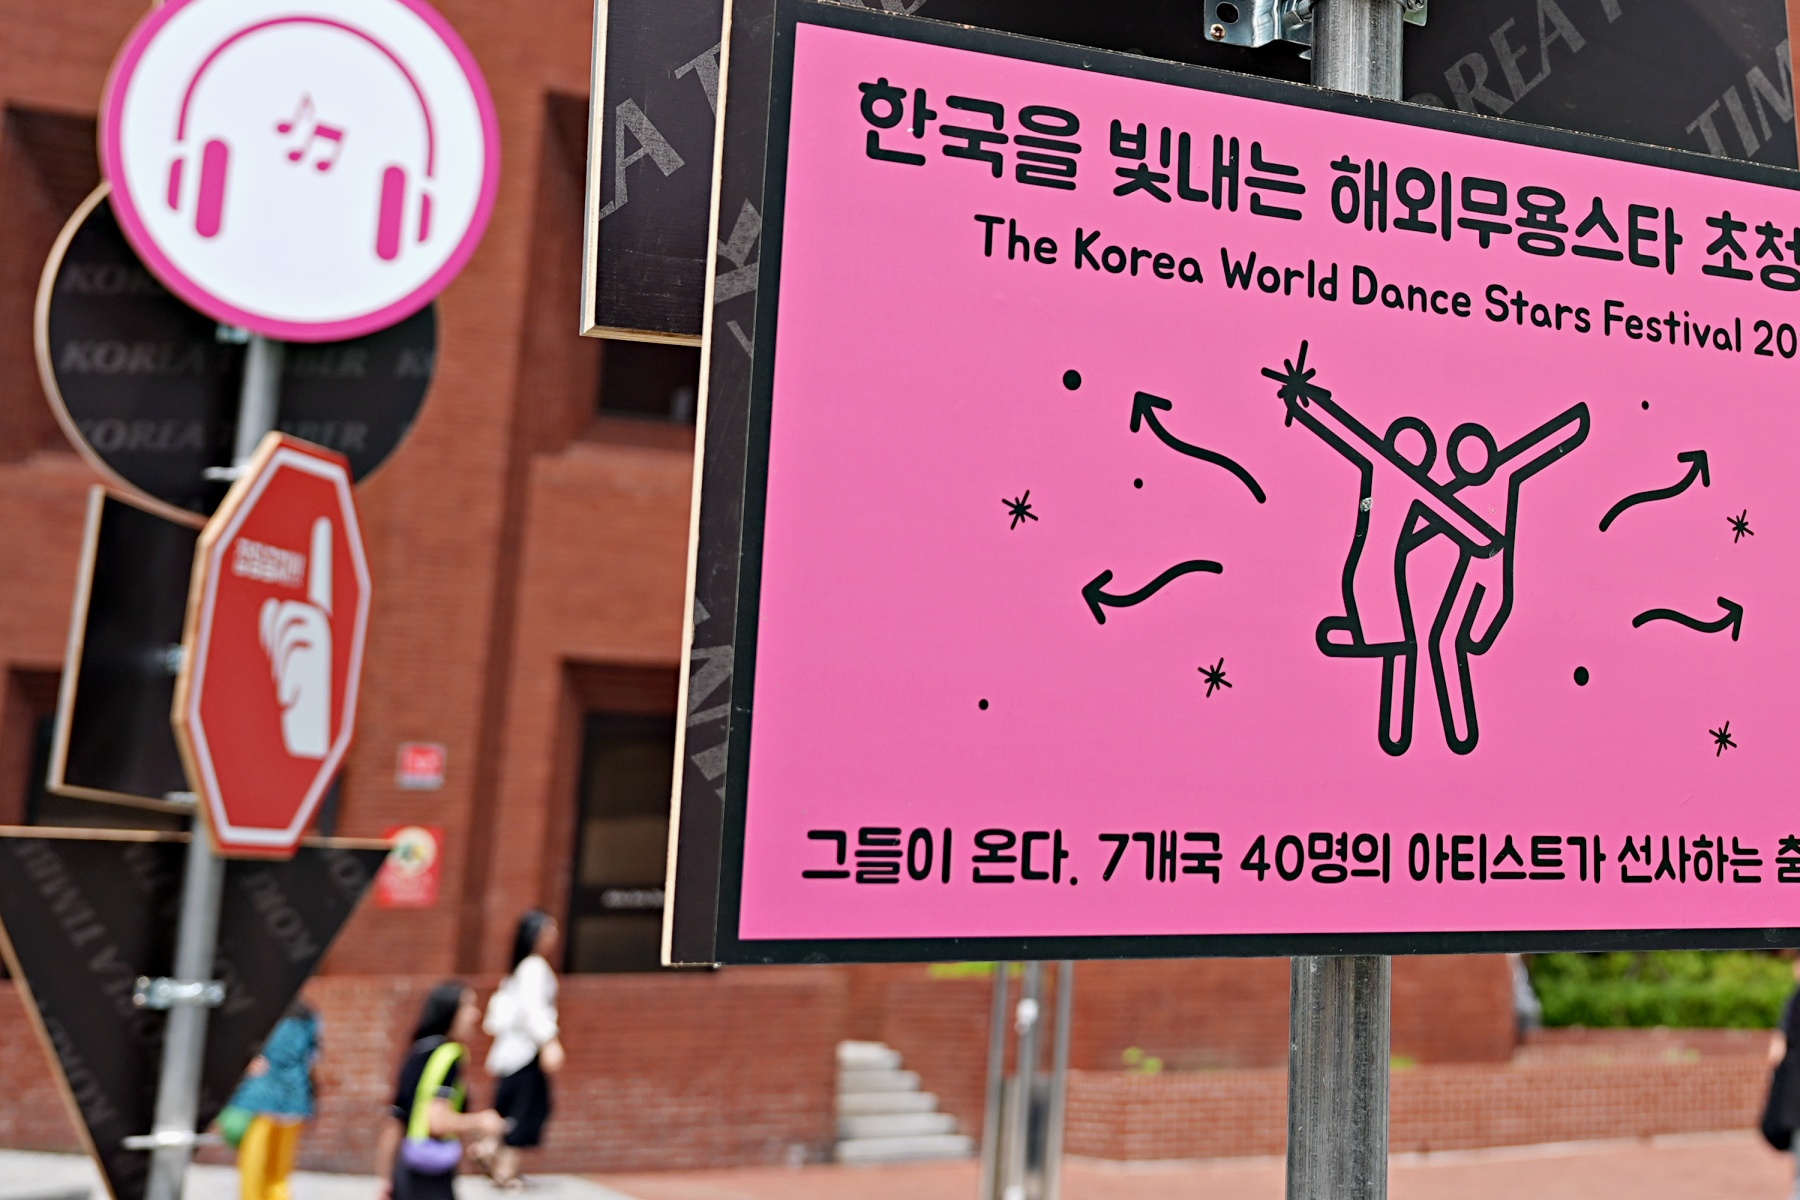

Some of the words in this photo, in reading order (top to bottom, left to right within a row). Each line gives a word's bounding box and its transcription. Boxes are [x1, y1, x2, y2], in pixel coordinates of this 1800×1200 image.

[859, 78, 1081, 190] 한국을
[1110, 120, 1305, 220] 빛내는
[1331, 155, 1683, 274] 해외무용스타
[975, 215, 1057, 264] The
[1075, 228, 1203, 283] Korea
[1221, 248, 1337, 301] World
[1353, 265, 1471, 317] Dance
[1486, 284, 1590, 333] Stars
[1605, 300, 1741, 352] Festival
[802, 828, 952, 883] 그들이
[972, 829, 1077, 885] 온다.
[1099, 831, 1222, 883] 7개국
[1241, 832, 1390, 883] 40명의
[1409, 833, 1606, 883] 아티스트가
[1618, 834, 1762, 883] 선사하는
